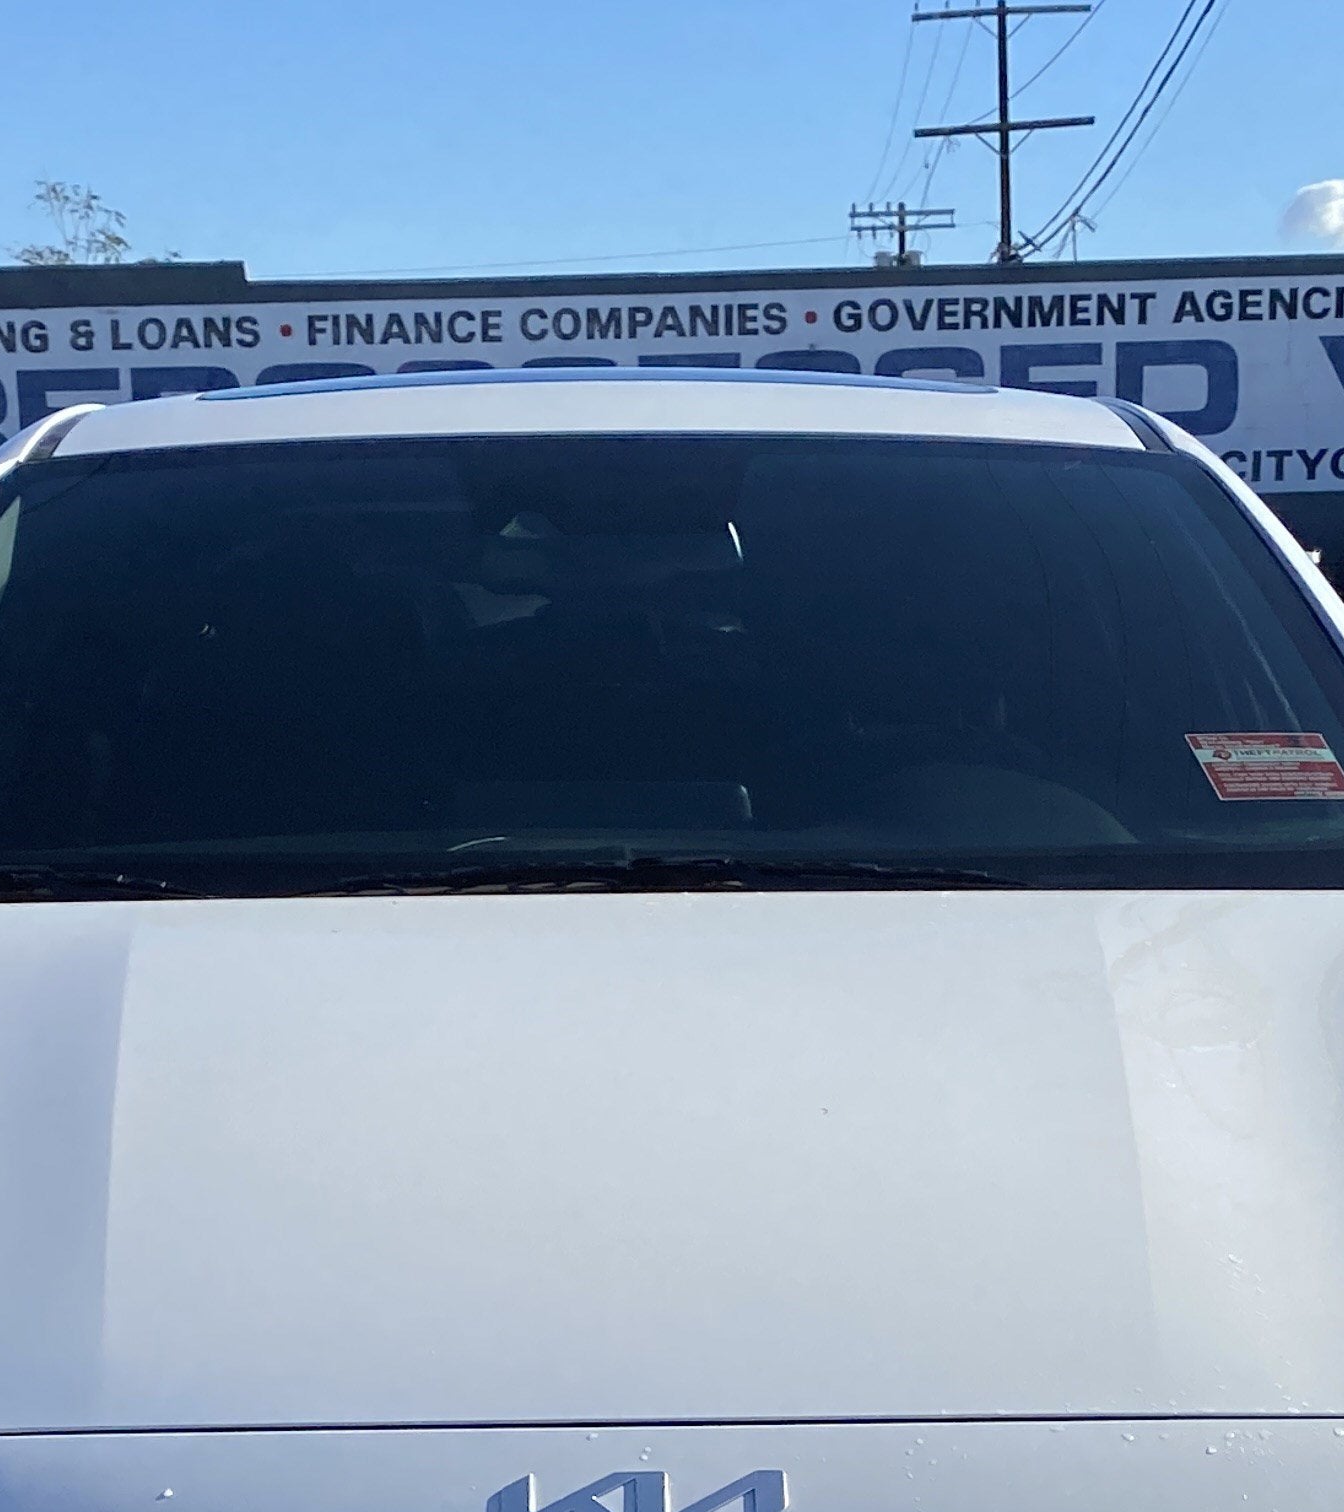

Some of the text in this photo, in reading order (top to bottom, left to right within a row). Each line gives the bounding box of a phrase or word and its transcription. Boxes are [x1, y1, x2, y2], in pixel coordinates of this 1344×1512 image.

[69, 318, 95, 352] &
[111, 315, 261, 350] LOANS
[307, 309, 503, 346] FINANCE
[519, 301, 788, 343] COMPANIES
[833, 291, 1156, 333] GOVERNMENT
